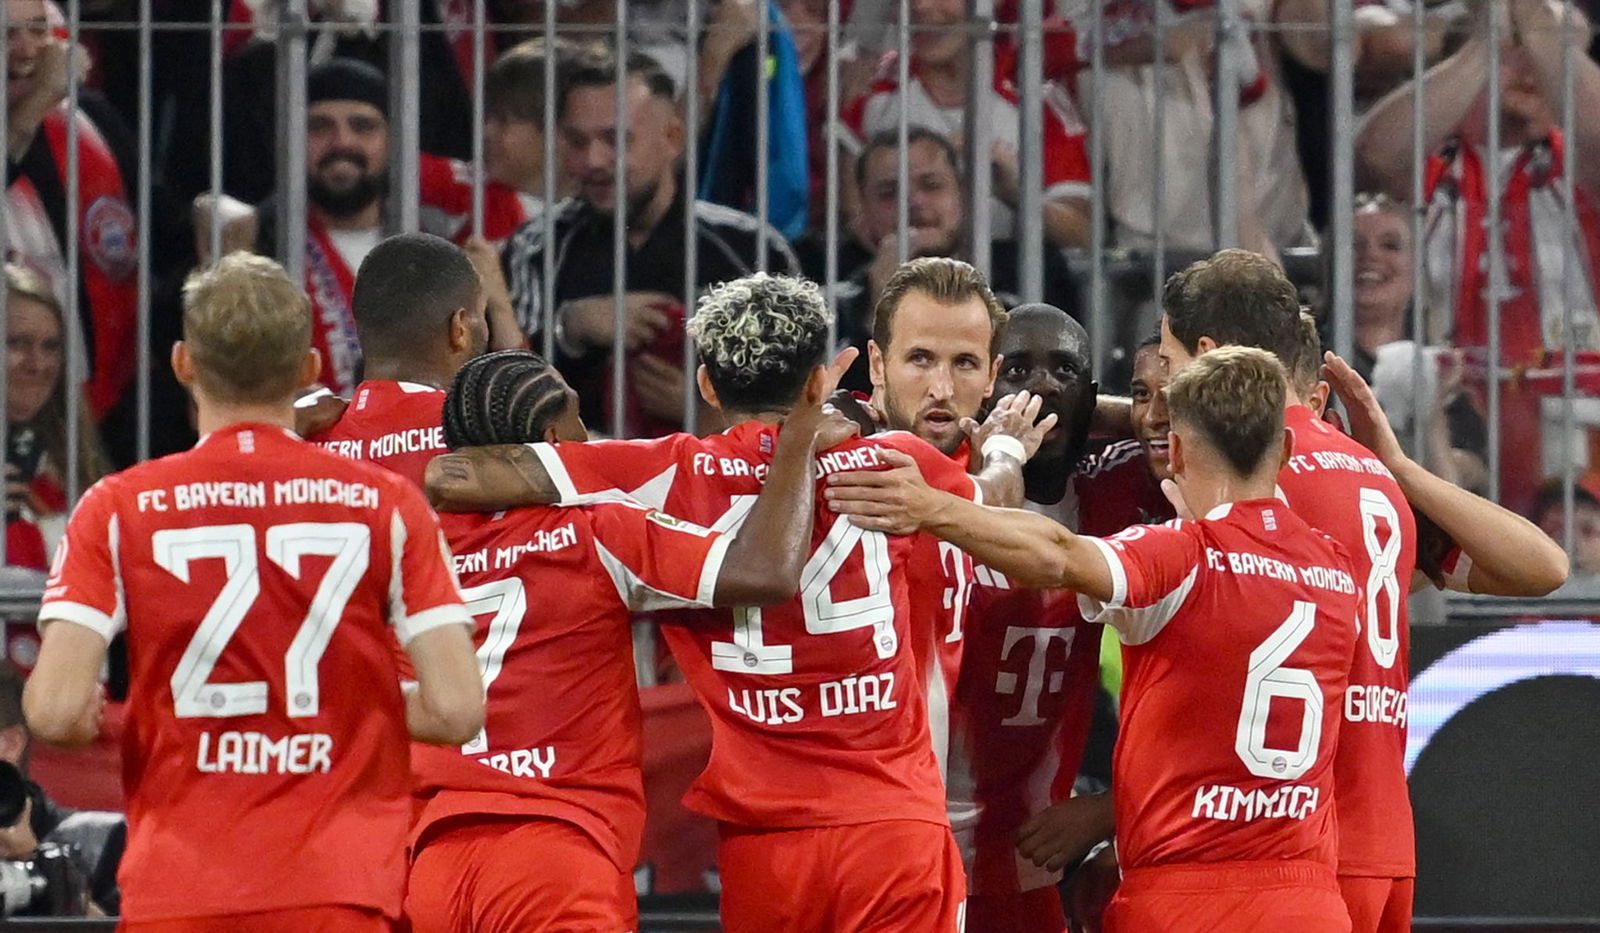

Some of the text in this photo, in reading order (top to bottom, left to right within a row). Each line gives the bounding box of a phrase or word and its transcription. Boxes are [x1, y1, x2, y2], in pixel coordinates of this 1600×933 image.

[369, 426, 447, 459] MÜNCHE
[693, 452, 716, 476] FC
[816, 443, 887, 480] NCHEN
[1288, 455, 1316, 474] FC
[137, 489, 168, 512] FC
[174, 481, 266, 511] BAYERN
[494, 522, 578, 569] MCHEN
[1206, 547, 1226, 571] FC
[1228, 552, 1298, 582] BAYERN
[1359, 487, 1402, 669] 8
[152, 522, 370, 718] 27
[460, 576, 527, 755] 7
[995, 625, 1076, 726] T
[727, 672, 897, 725] LUIS DÍAZ
[1234, 600, 1324, 780] 6
[197, 732, 333, 774] LAIMER
[1191, 785, 1320, 822] KIMMICH
